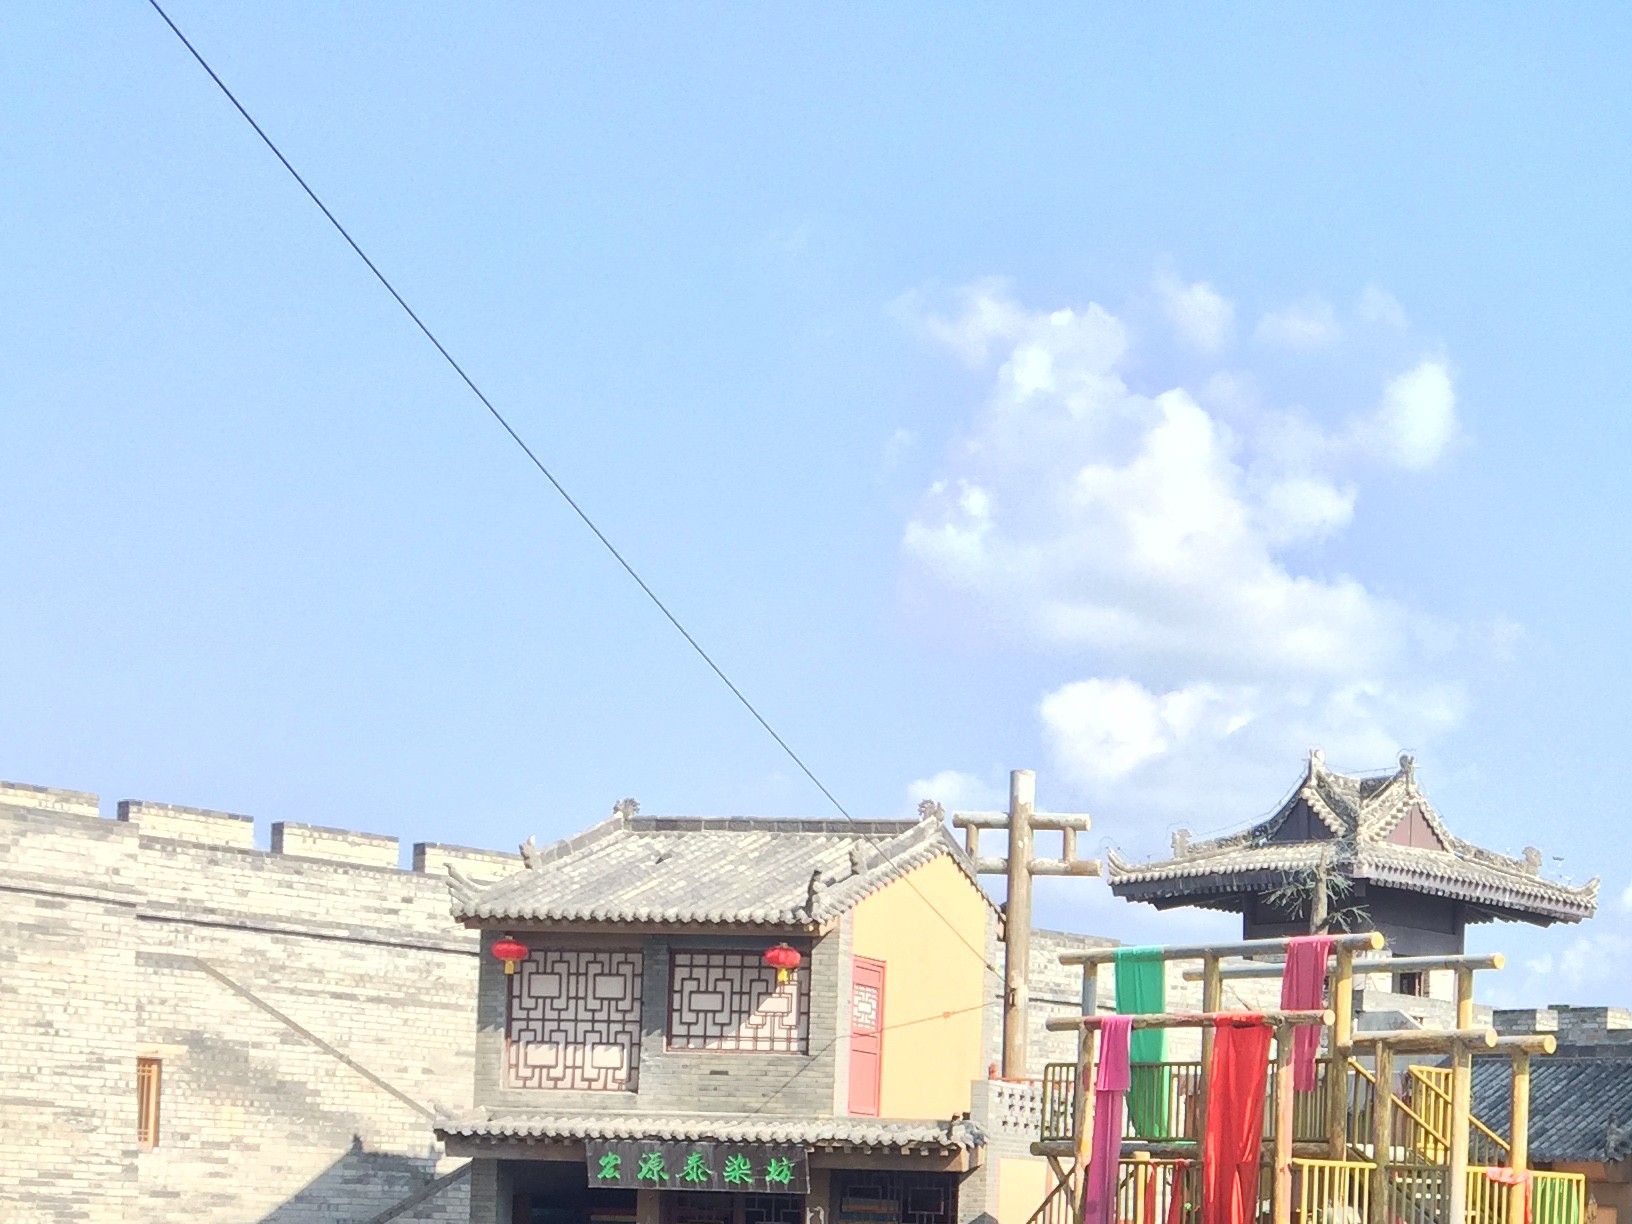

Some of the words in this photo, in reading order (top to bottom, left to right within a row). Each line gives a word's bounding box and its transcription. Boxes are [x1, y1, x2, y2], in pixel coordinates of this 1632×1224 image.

[597, 1151, 795, 1185] 宏源泰染坊
